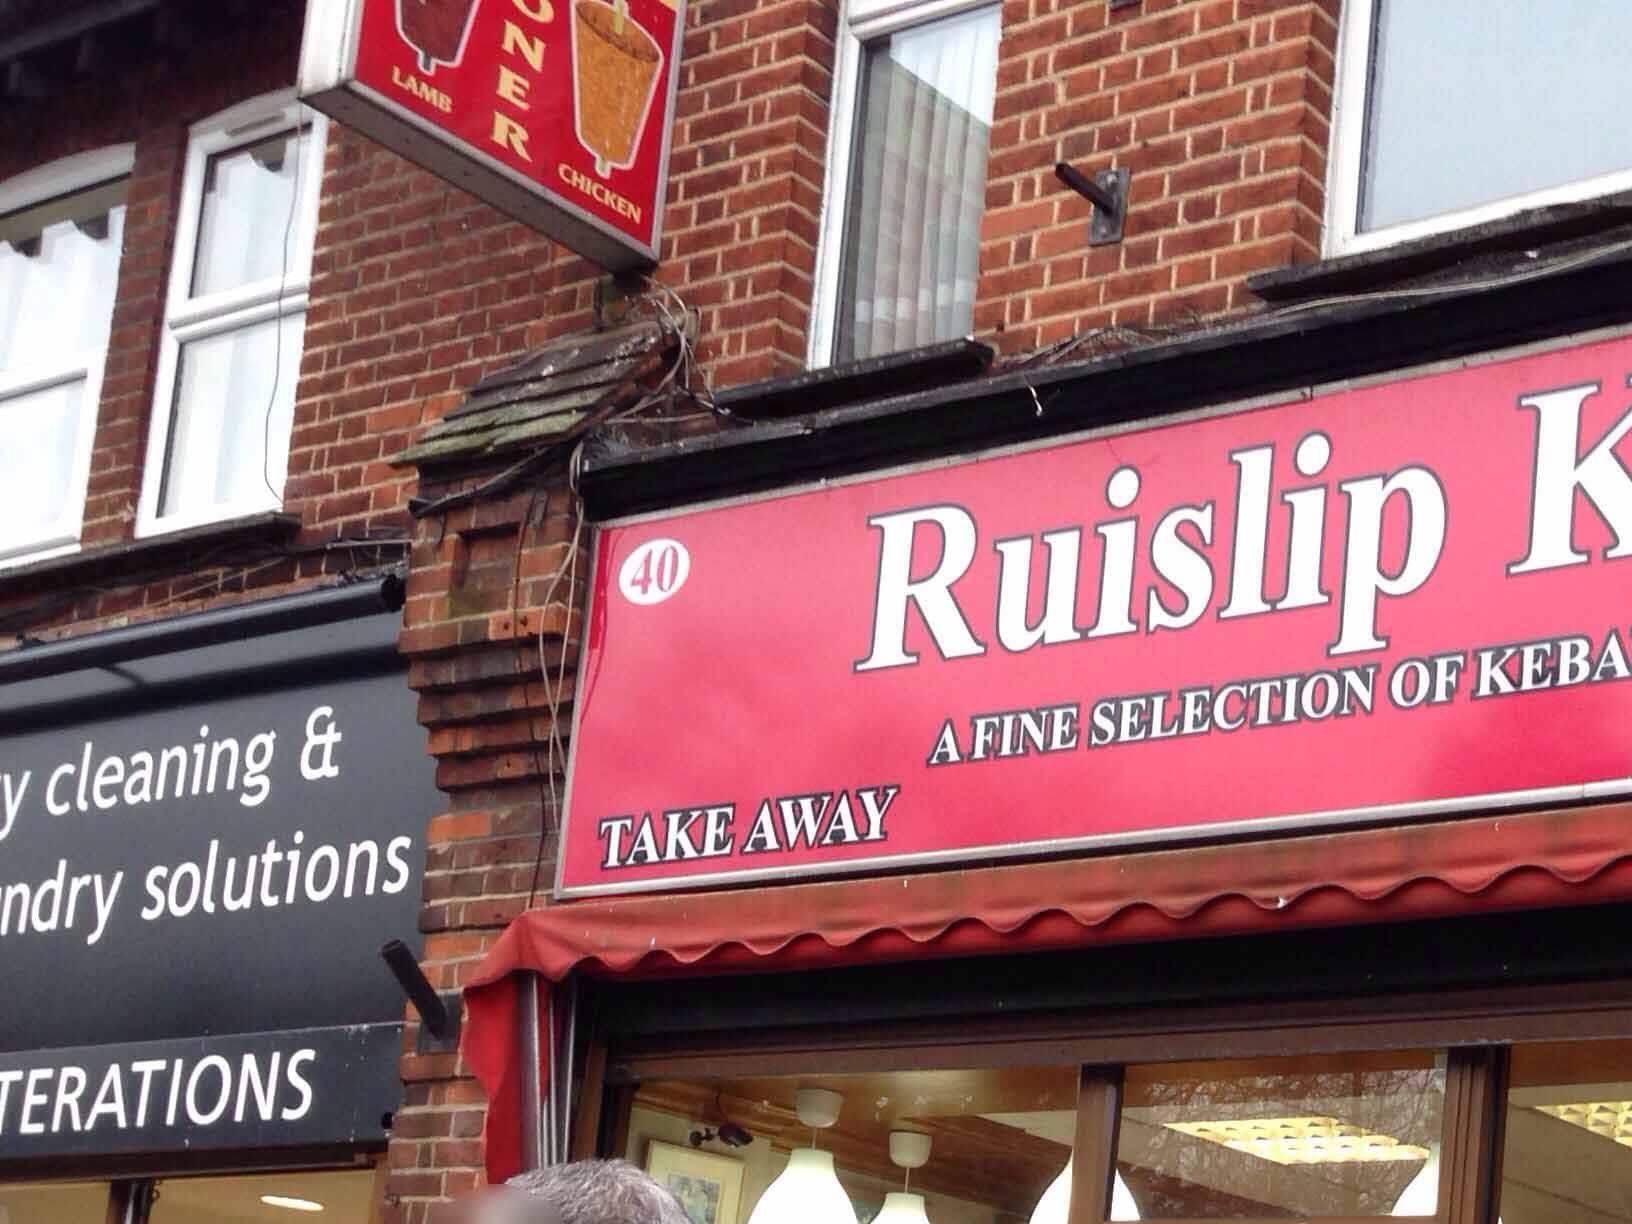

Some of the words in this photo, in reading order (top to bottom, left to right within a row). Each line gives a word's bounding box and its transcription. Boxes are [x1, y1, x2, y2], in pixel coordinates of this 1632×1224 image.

[392, 65, 453, 113] LAMB
[558, 163, 642, 224] CHICKEN
[630, 544, 680, 597] 40
[853, 430, 1447, 671] Ruislip
[928, 720, 963, 766] A
[968, 705, 1079, 761] FINE
[1090, 665, 1379, 749] SELECTION
[1389, 653, 1463, 710] OF
[0, 770, 32, 841] y
[45, 724, 277, 816] cleaning
[300, 705, 342, 781] &
[598, 804, 736, 871] TAKE
[742, 785, 900, 855] AWAY
[0, 859, 124, 945] ndry
[141, 831, 411, 921] solutions
[0, 1048, 316, 1136] TERATIONS
